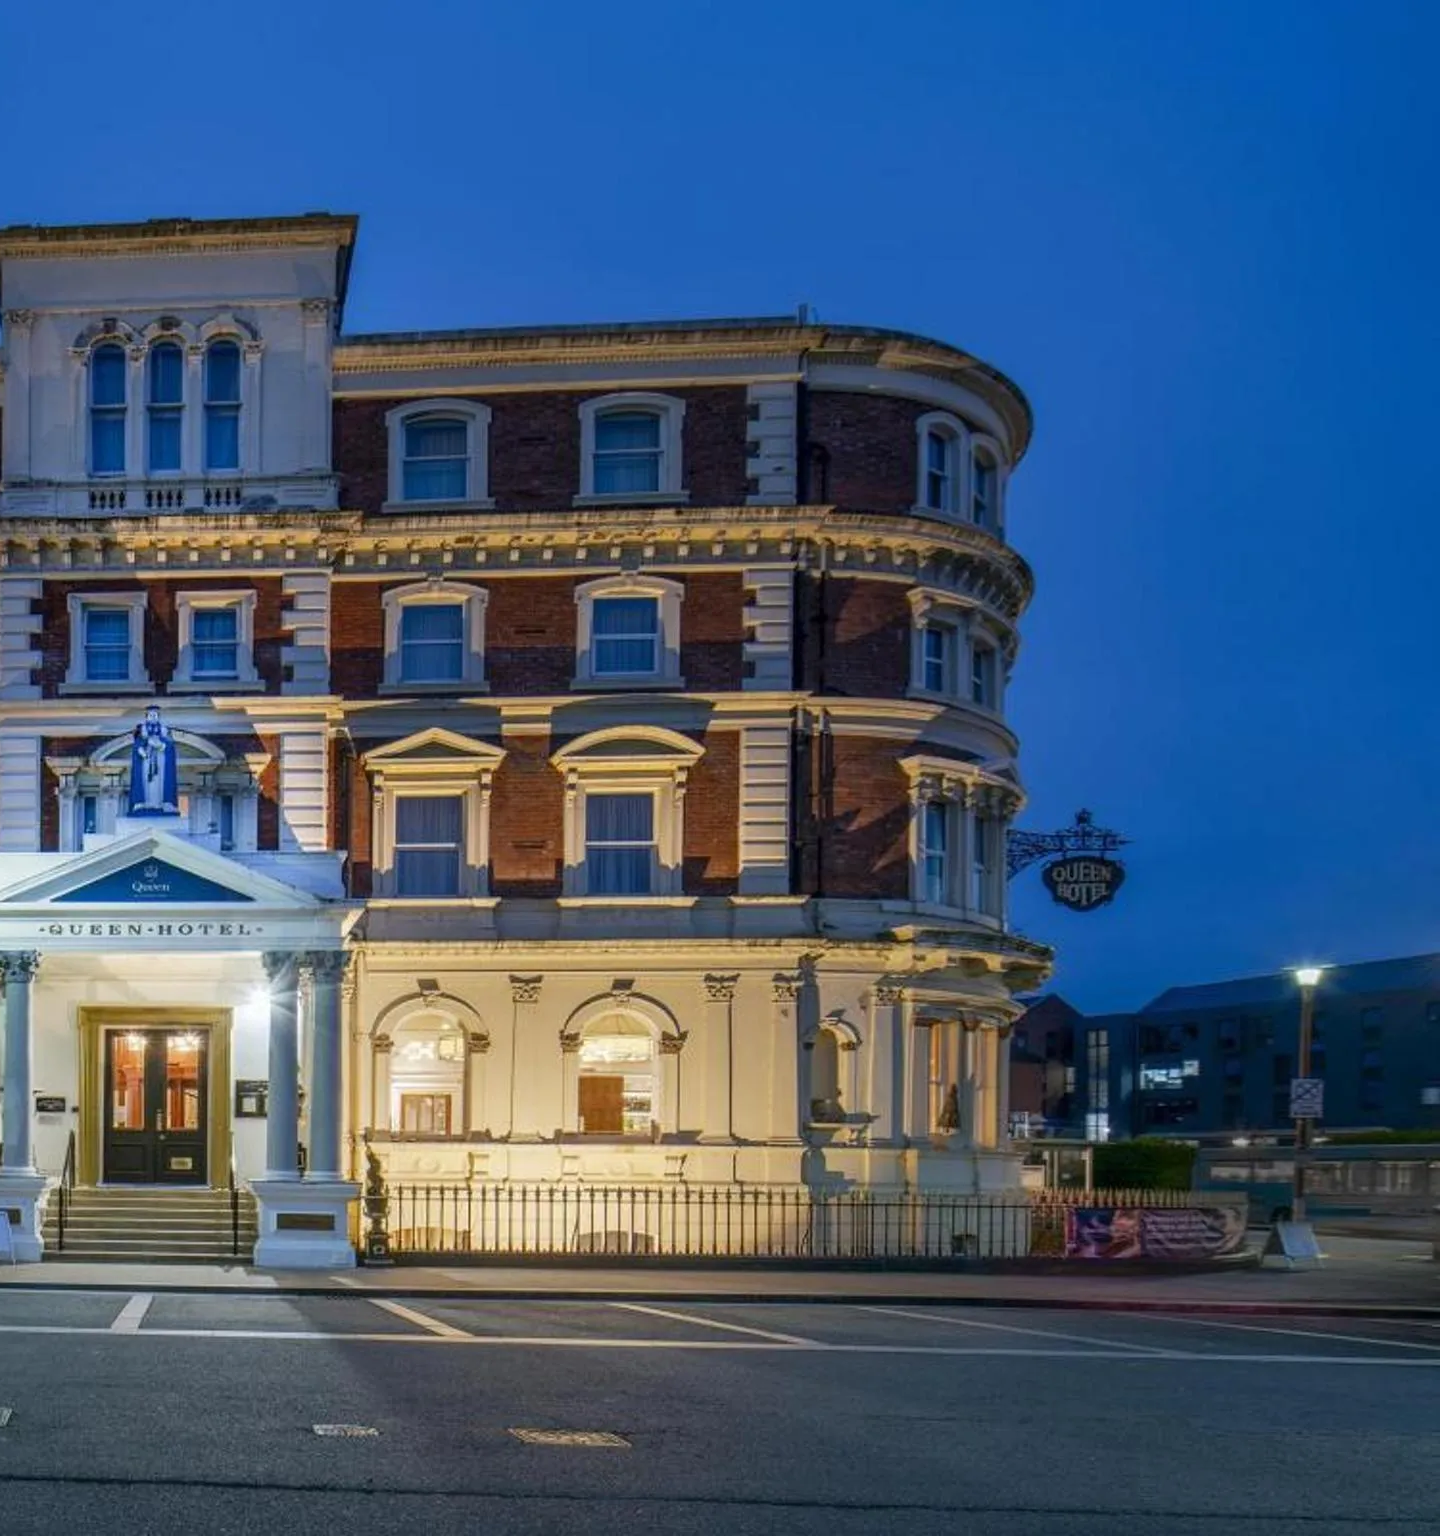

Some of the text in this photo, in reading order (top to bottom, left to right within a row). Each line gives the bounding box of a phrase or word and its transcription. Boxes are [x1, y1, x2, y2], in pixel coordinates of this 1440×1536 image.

[1053, 862, 1111, 882] QUEEN
[131, 880, 170, 893] Queen
[1058, 883, 1109, 906] HOTEL
